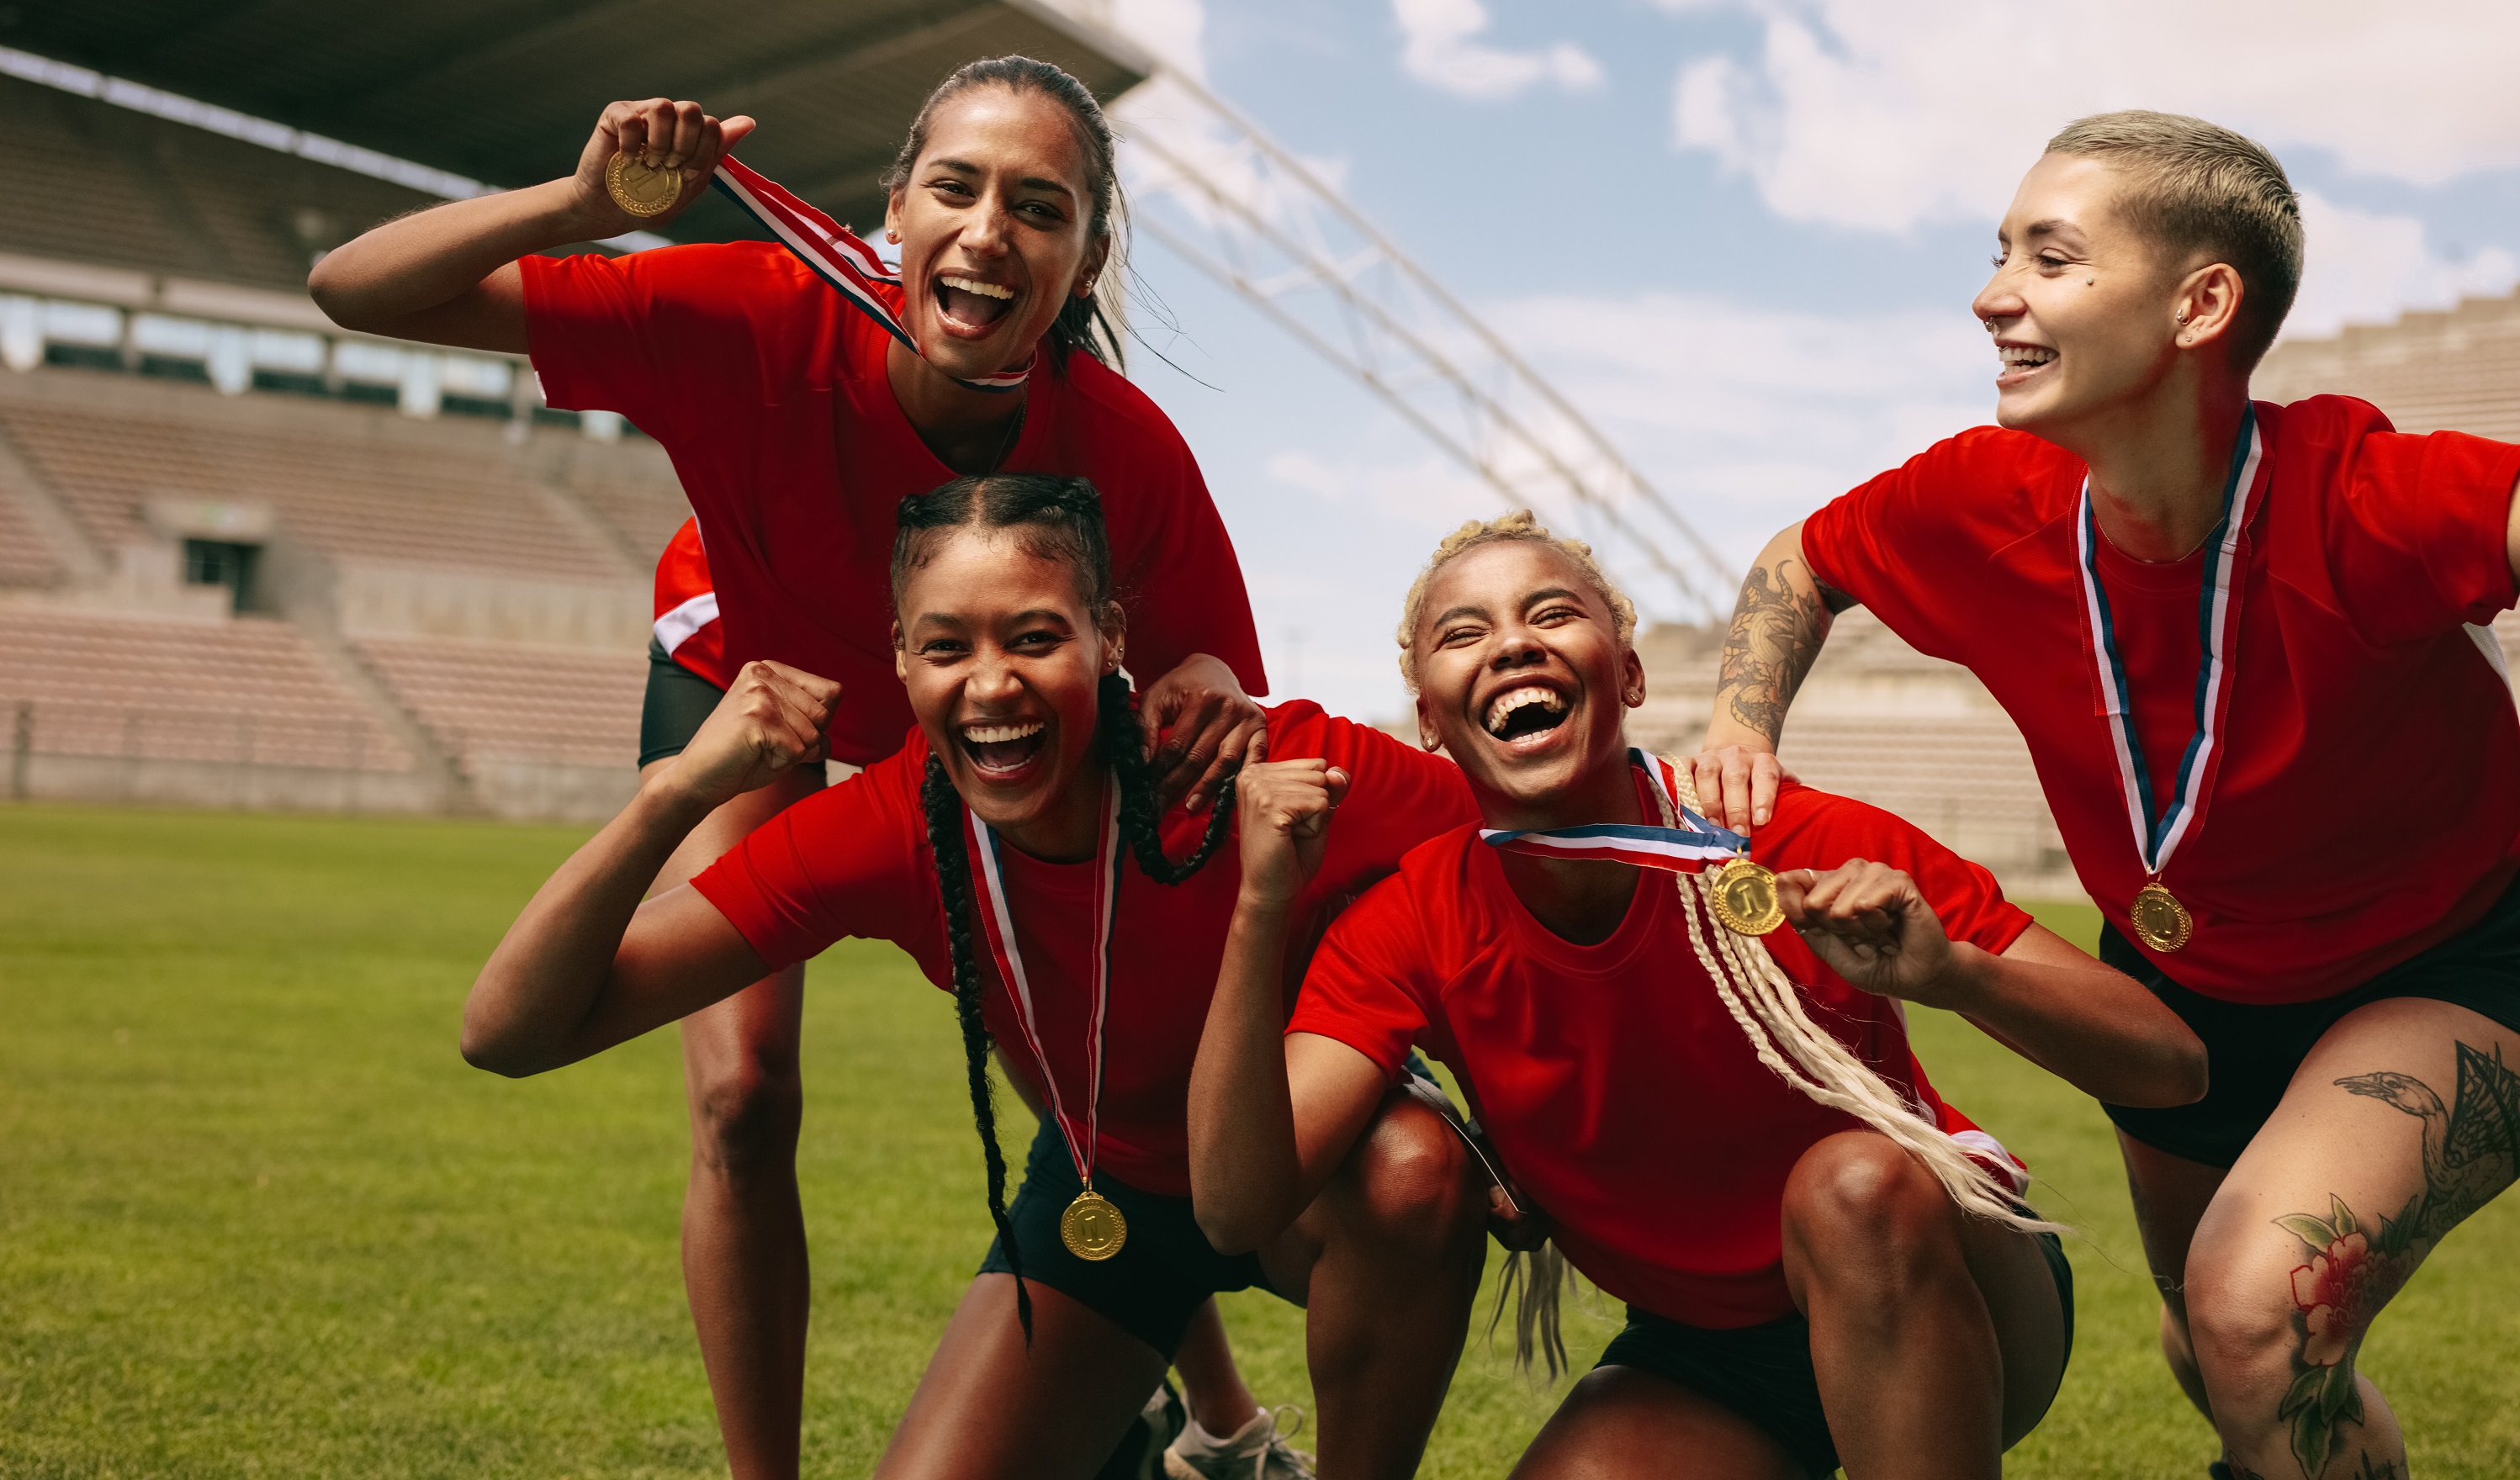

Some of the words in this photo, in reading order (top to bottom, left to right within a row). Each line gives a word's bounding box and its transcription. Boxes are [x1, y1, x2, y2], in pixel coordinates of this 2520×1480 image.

[1736, 883, 1764, 917] 1
[2152, 906, 2172, 933] 1
[1084, 1215, 1104, 1242] 1
